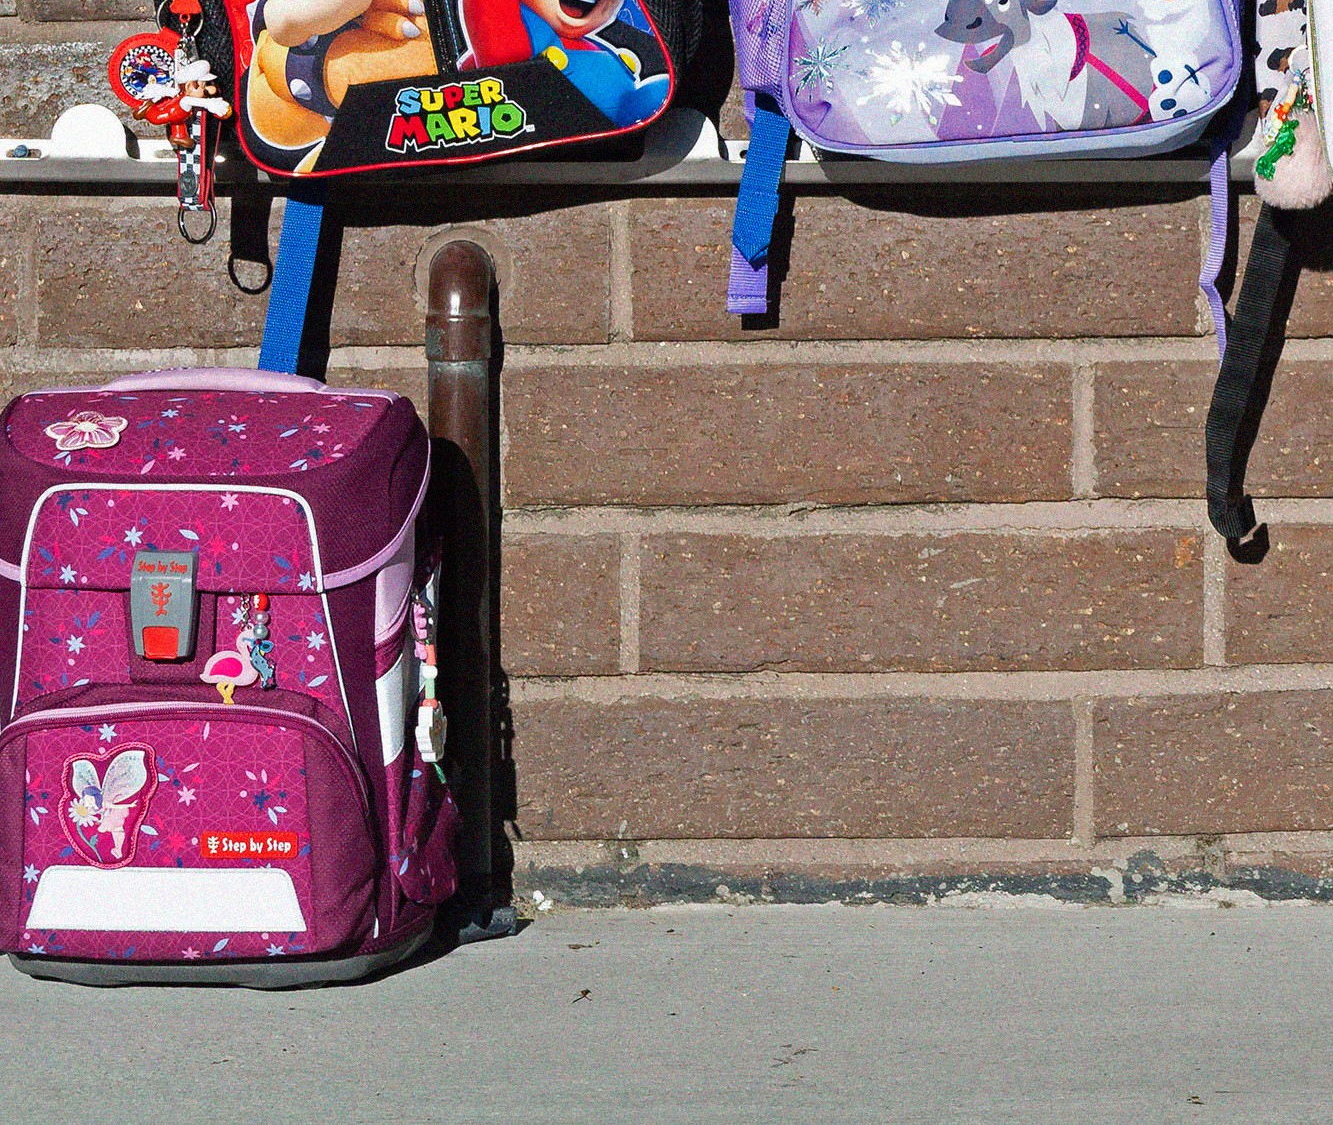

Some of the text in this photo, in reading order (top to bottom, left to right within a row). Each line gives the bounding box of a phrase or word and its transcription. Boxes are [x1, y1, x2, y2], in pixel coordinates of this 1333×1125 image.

[397, 78, 504, 115] SUPER
[388, 102, 523, 147] MARIO
[222, 837, 291, 854] Step by Step
